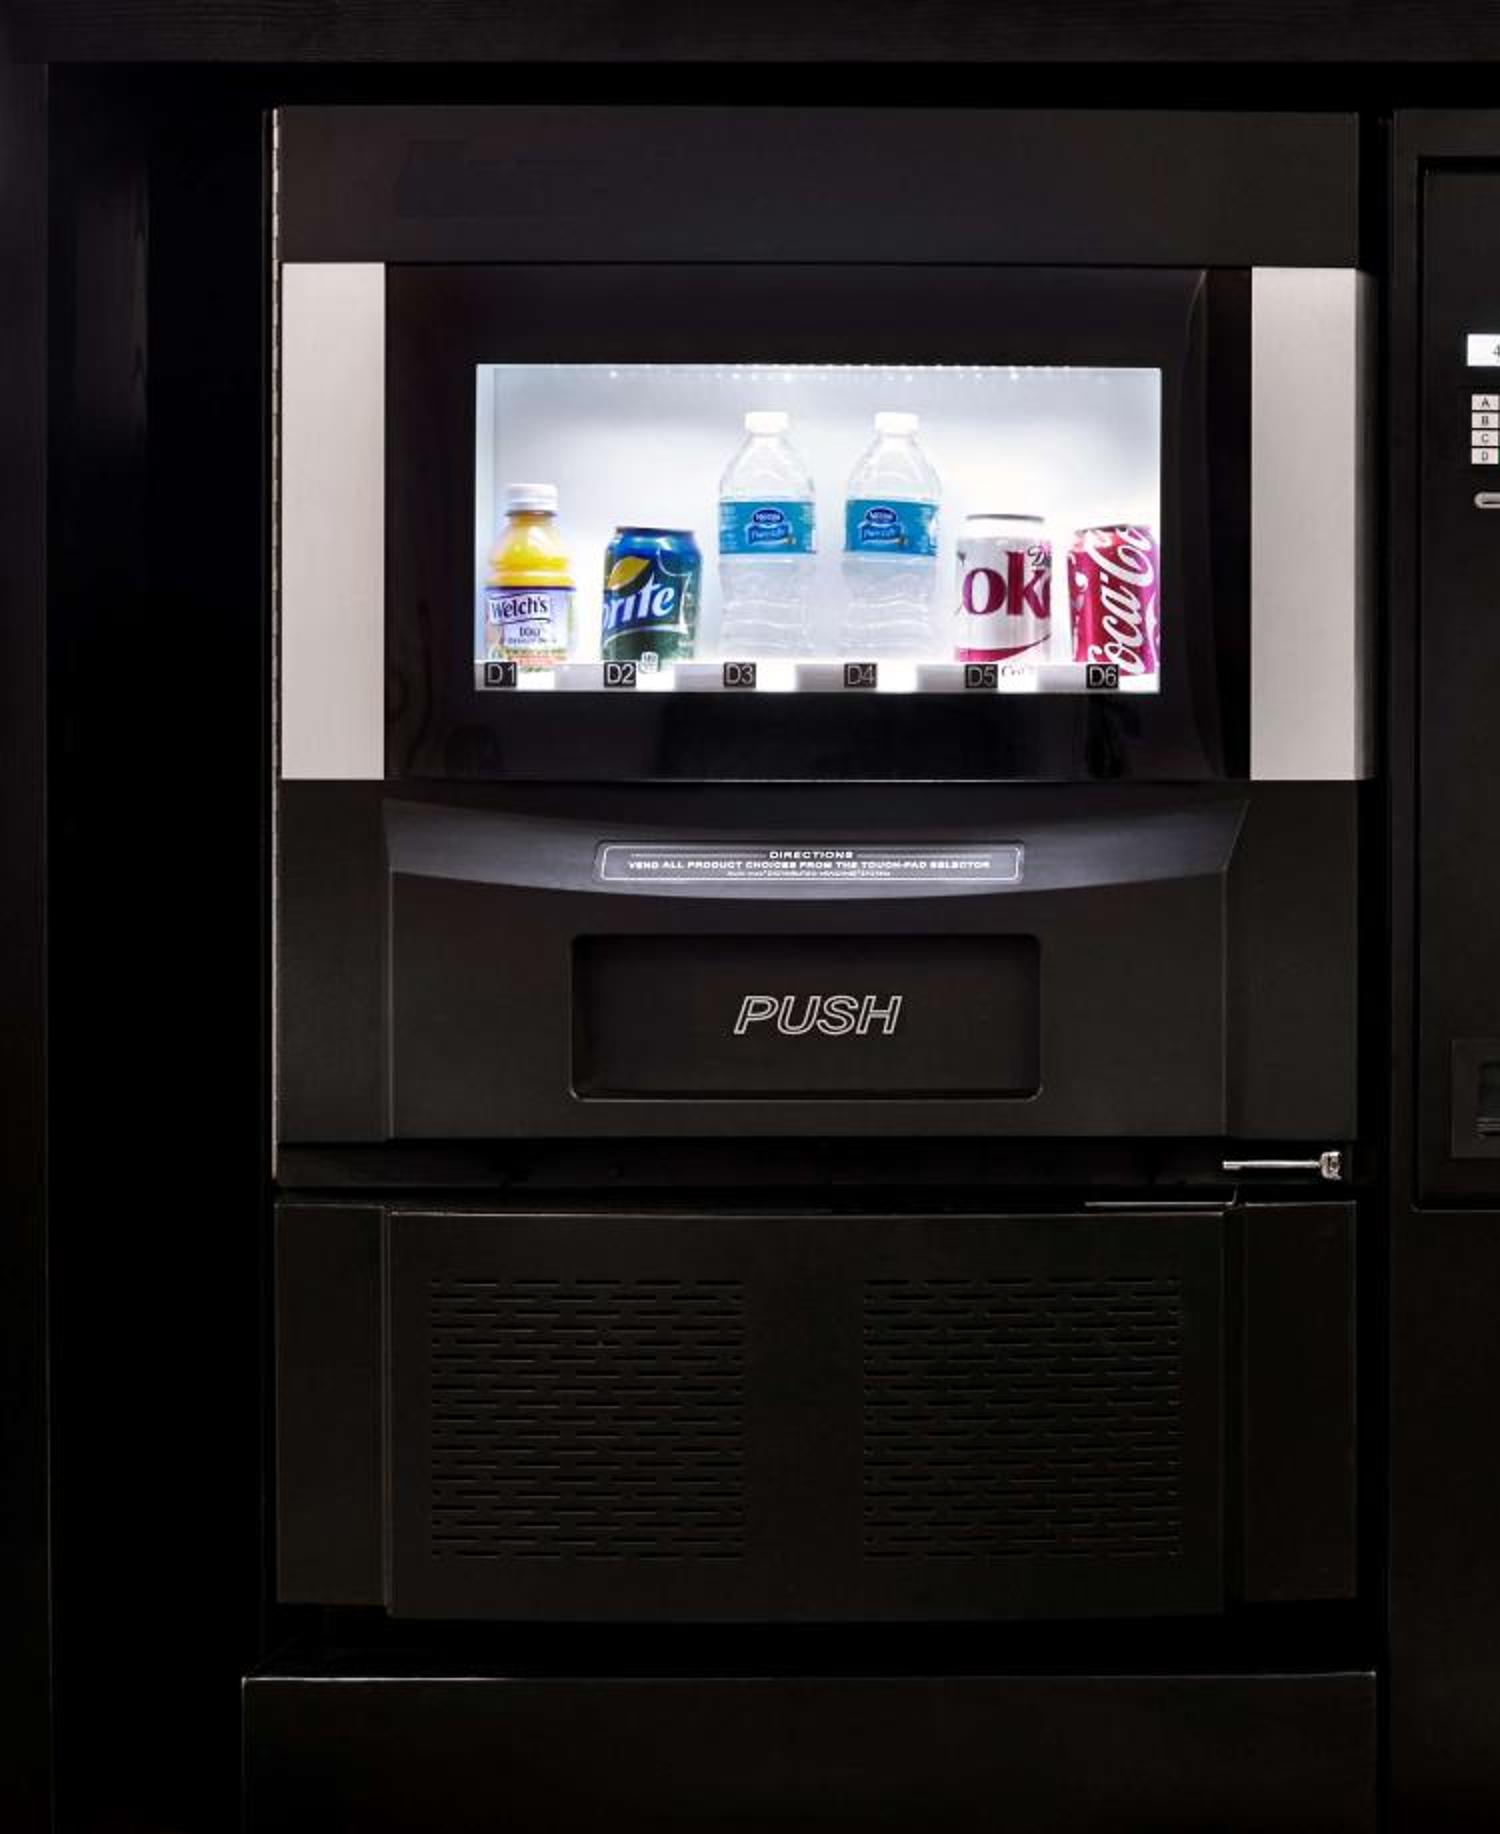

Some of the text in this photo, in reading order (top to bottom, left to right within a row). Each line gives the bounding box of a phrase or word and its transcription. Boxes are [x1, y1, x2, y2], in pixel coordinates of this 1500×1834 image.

[959, 551, 1052, 618] ok
[490, 593, 548, 618] Welch's
[601, 573, 675, 629] rite
[487, 664, 516, 684] D1
[606, 664, 635, 684] D2
[725, 664, 754, 685] D3
[847, 664, 875, 685] D4
[967, 666, 996, 687] D5
[1089, 666, 1117, 687] D6
[629, 861, 990, 869] VEND ALL PRODUCT CHOICES FROM THE TOUCH-PAD SELECTOR
[769, 851, 853, 859] DIRECTIONS
[733, 995, 903, 1036] PUSH
